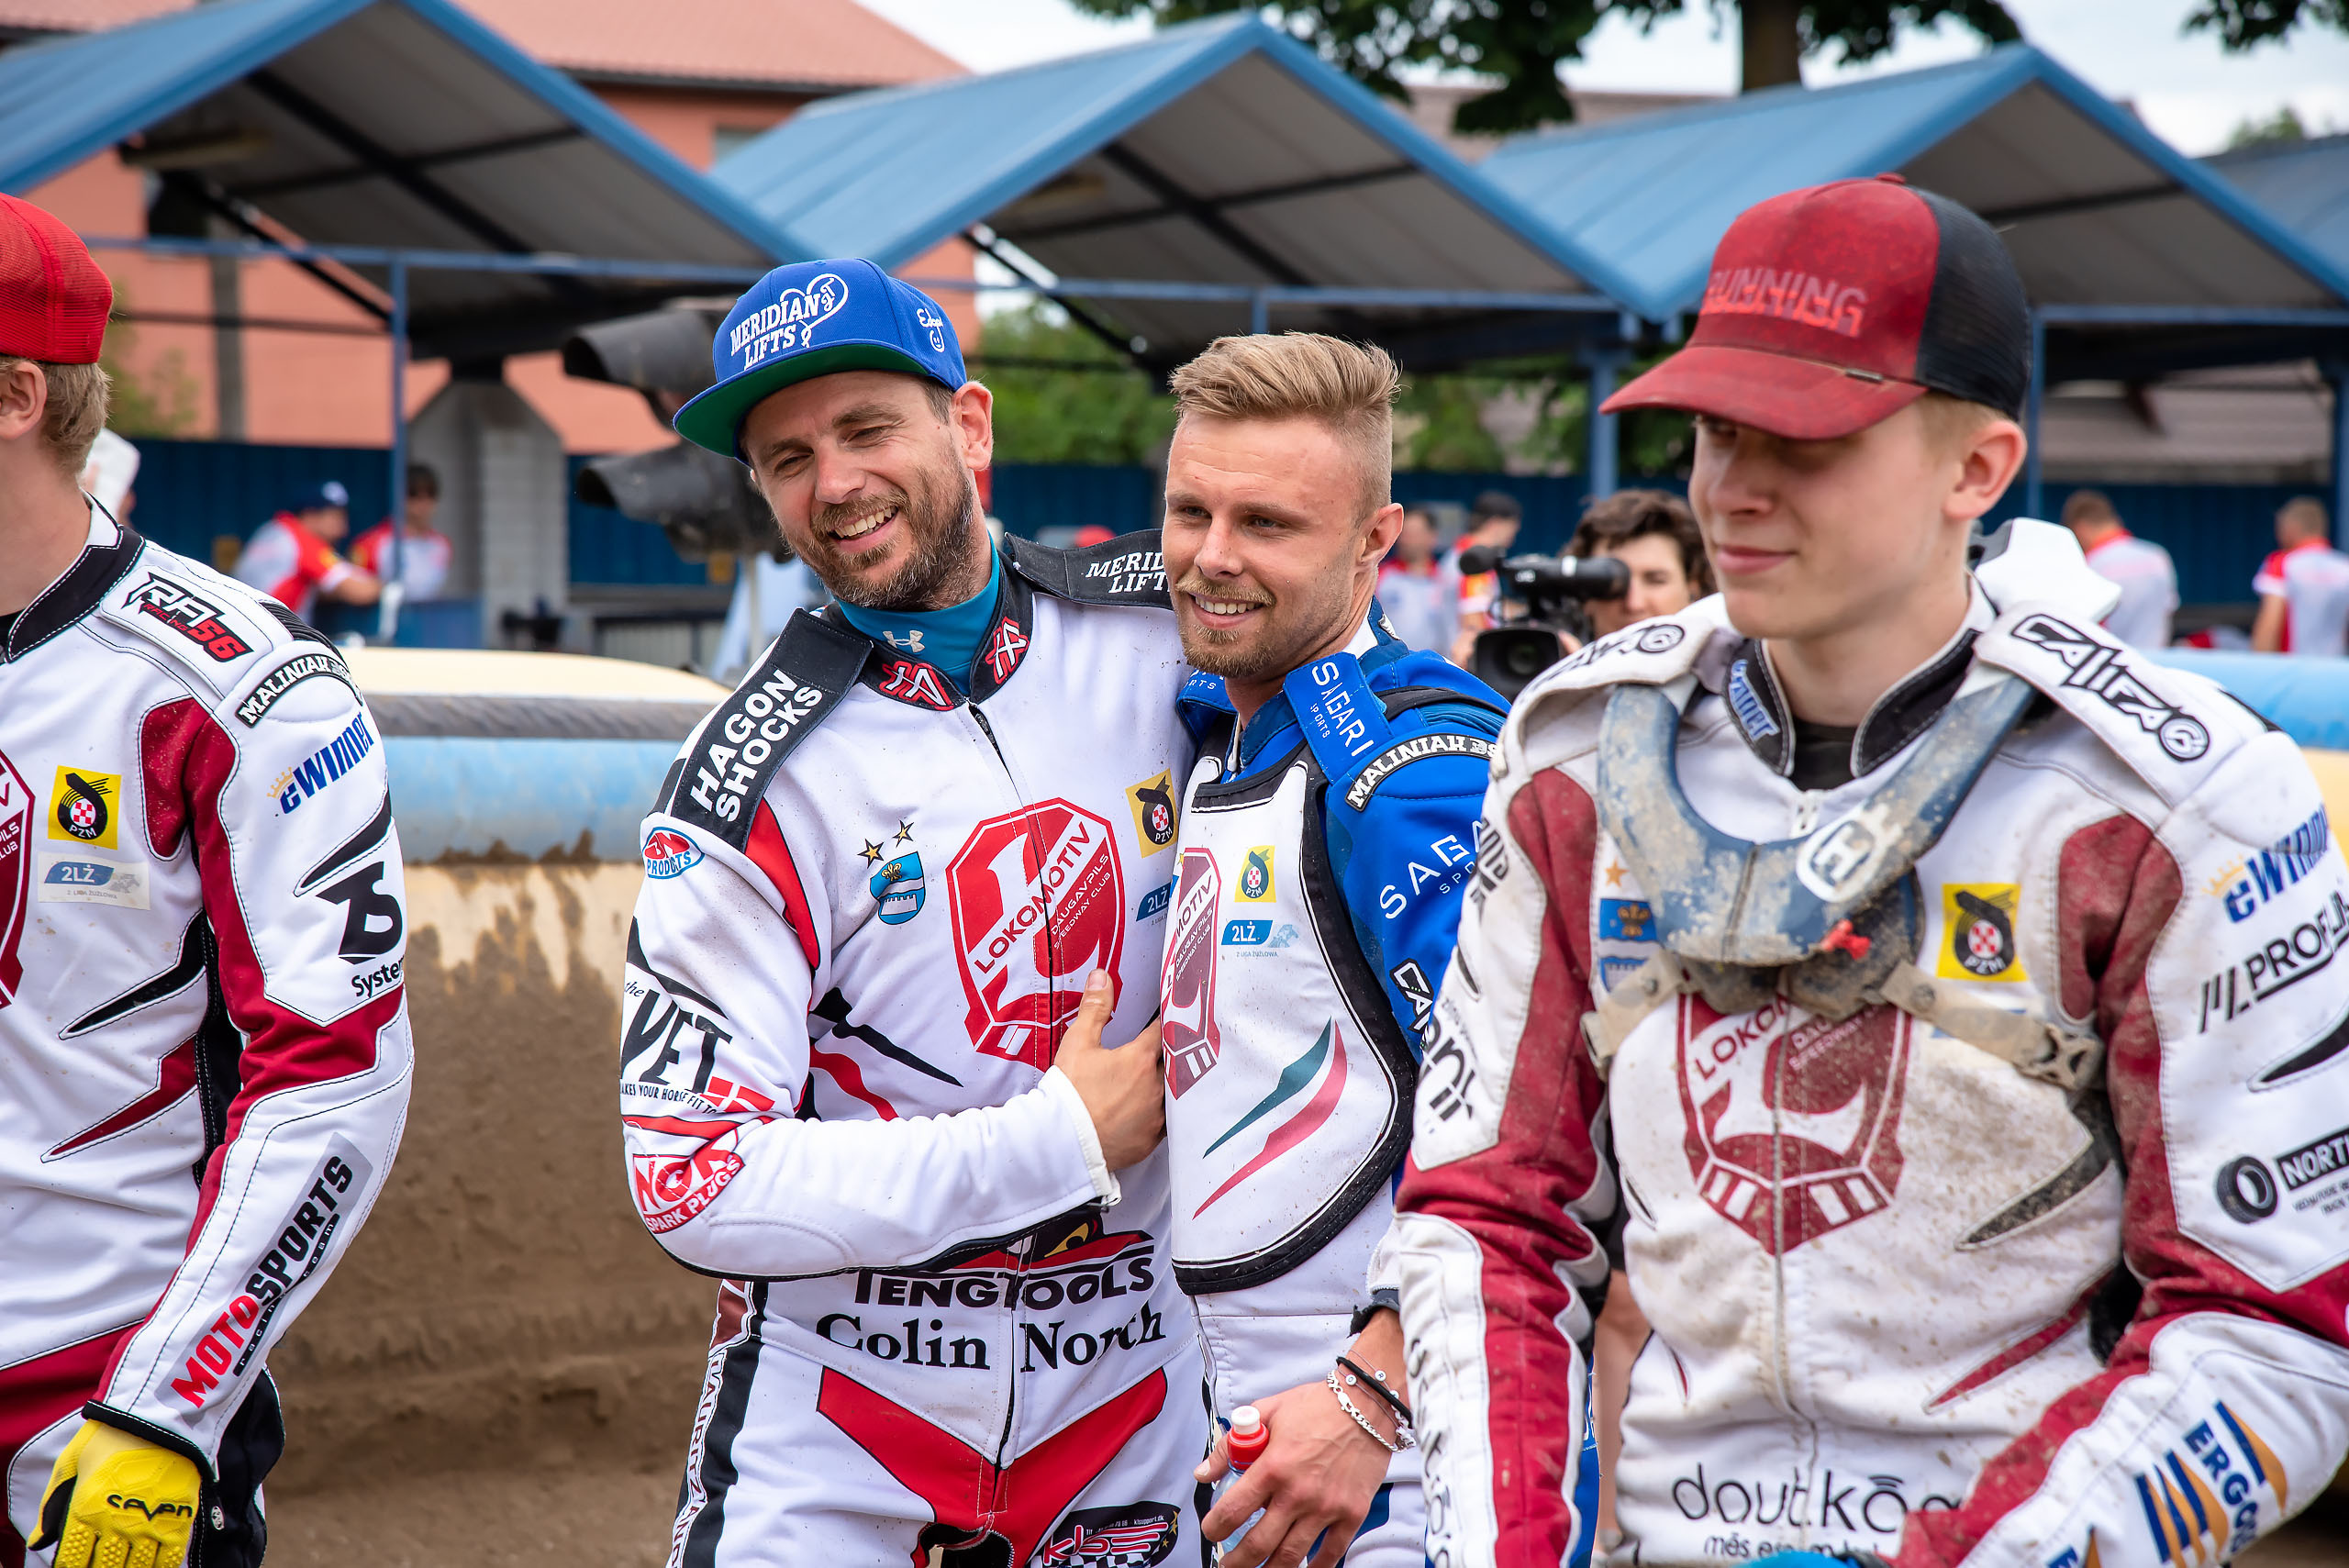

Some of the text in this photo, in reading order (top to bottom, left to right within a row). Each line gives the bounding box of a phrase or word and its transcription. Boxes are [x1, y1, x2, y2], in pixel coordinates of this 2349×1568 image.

[729, 293, 820, 356] MERIDIAN
[743, 324, 796, 371] LIFTS
[1085, 552, 1164, 578] MERID
[1108, 573, 1173, 594] LIFT
[1312, 662, 1374, 757] SAGARI
[280, 712, 374, 815] eWinner
[690, 669, 797, 812] HAGON
[716, 686, 823, 822] SHOCKS
[69, 824, 96, 839] PZM
[1154, 827, 1173, 842] PZM
[61, 864, 95, 884] 2LŻ
[974, 821, 1092, 974] LOKOMOTIV
[1051, 853, 1109, 936] DAUGAVPILS
[1147, 886, 1168, 913] 2LŻ
[1245, 885, 1263, 899] PZM
[1054, 872, 1111, 950] SEEDWAY CLUB
[1231, 920, 1257, 942] 2LŻ
[623, 980, 645, 998] the
[1965, 955, 2007, 974] PZM
[621, 988, 733, 1094] VET
[621, 1083, 637, 1096] AKES
[639, 1084, 660, 1099] YOUR
[687, 1094, 703, 1110] FIT
[2281, 1134, 2349, 1187] NORT
[646, 1158, 741, 1231] SPARK PLUGS
[239, 1224, 334, 1366] racin team
[817, 1300, 1166, 1373] Colin North
